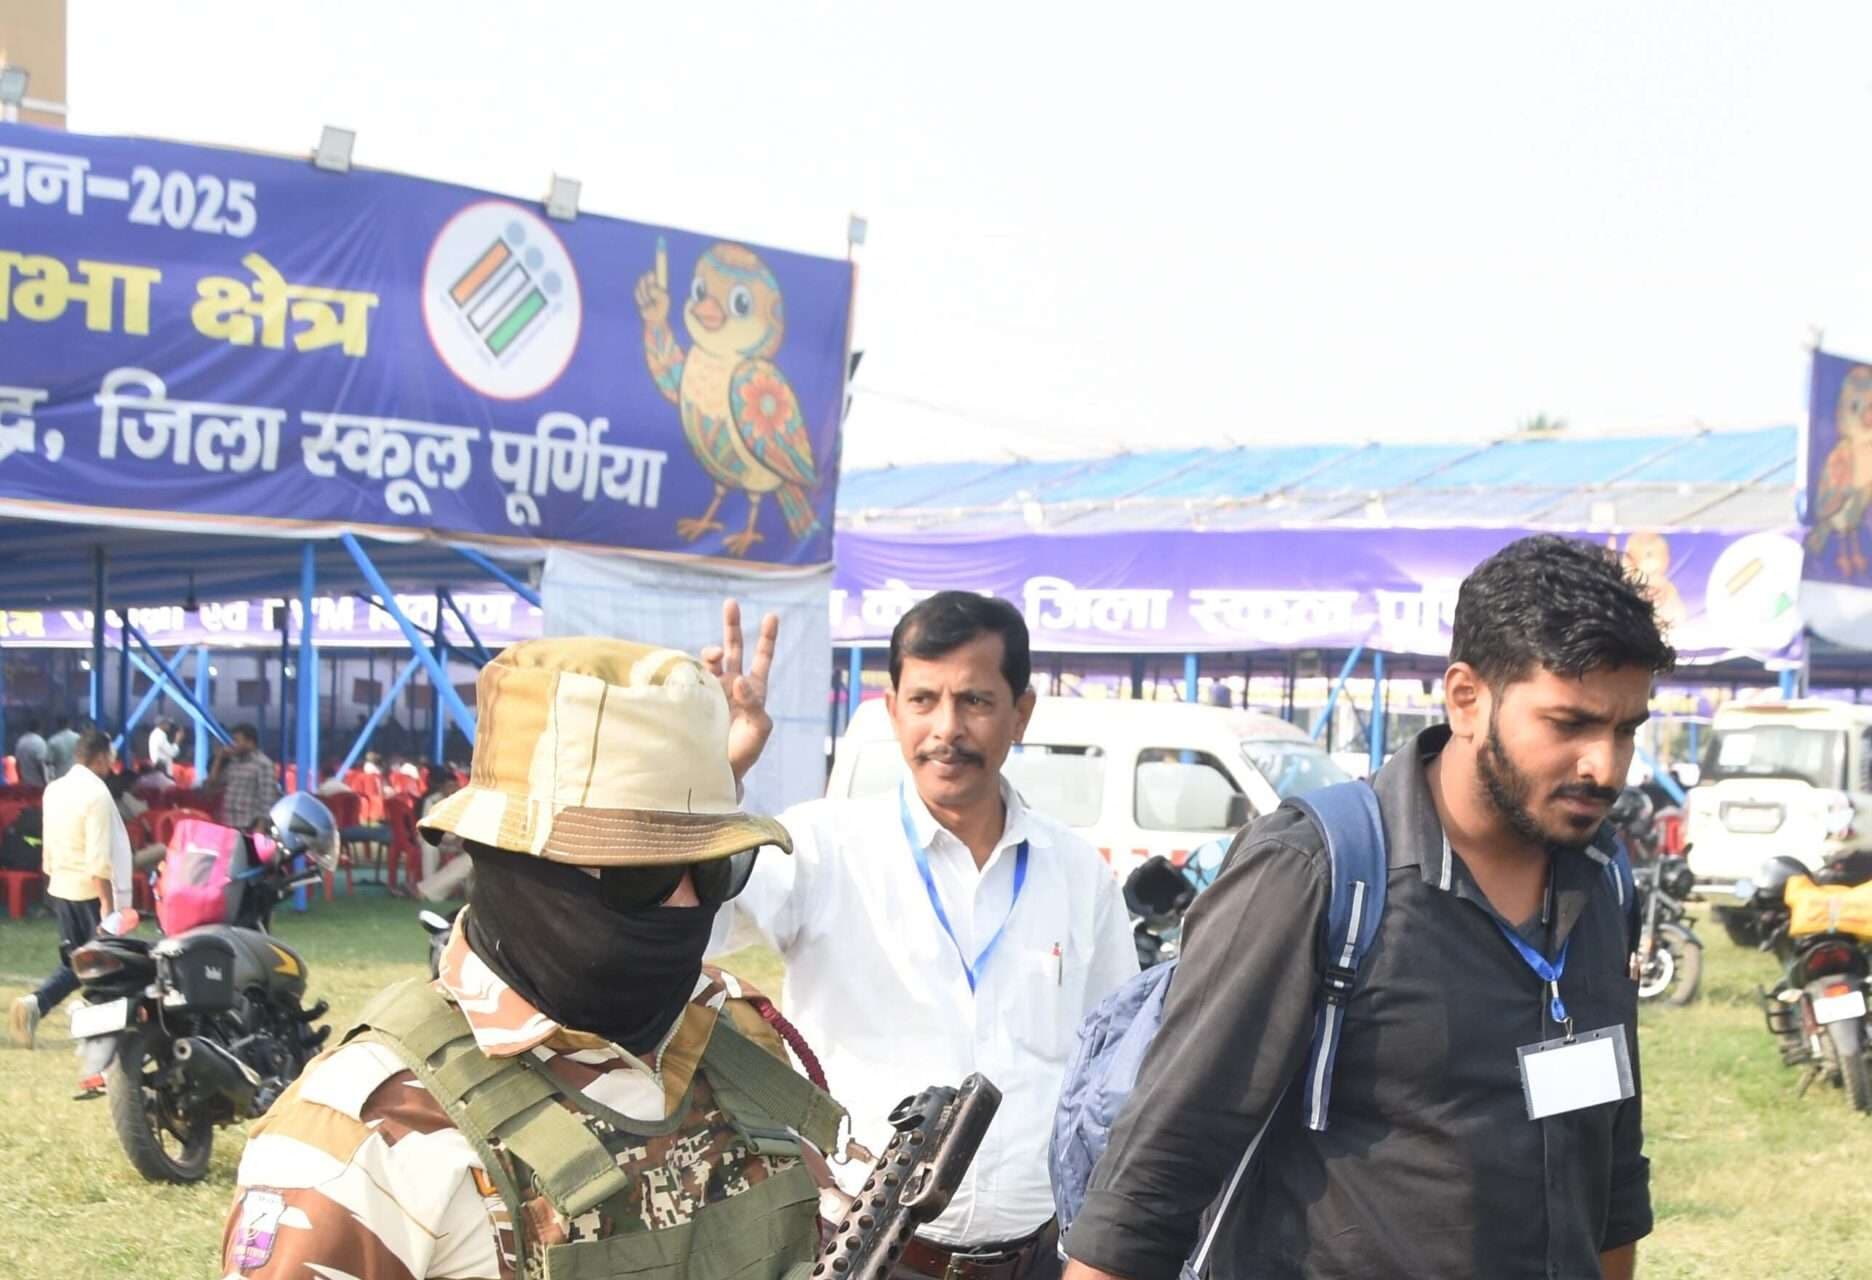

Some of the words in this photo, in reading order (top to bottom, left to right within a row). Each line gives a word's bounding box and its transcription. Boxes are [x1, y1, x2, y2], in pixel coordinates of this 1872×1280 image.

[0, 250, 161, 336] भा
[192, 252, 379, 359] क्षेत्र
[94, 366, 287, 473] जिला
[301, 410, 481, 516] स्कूल
[490, 410, 668, 526] पूर्णिया
[1024, 576, 1174, 632] जिला
